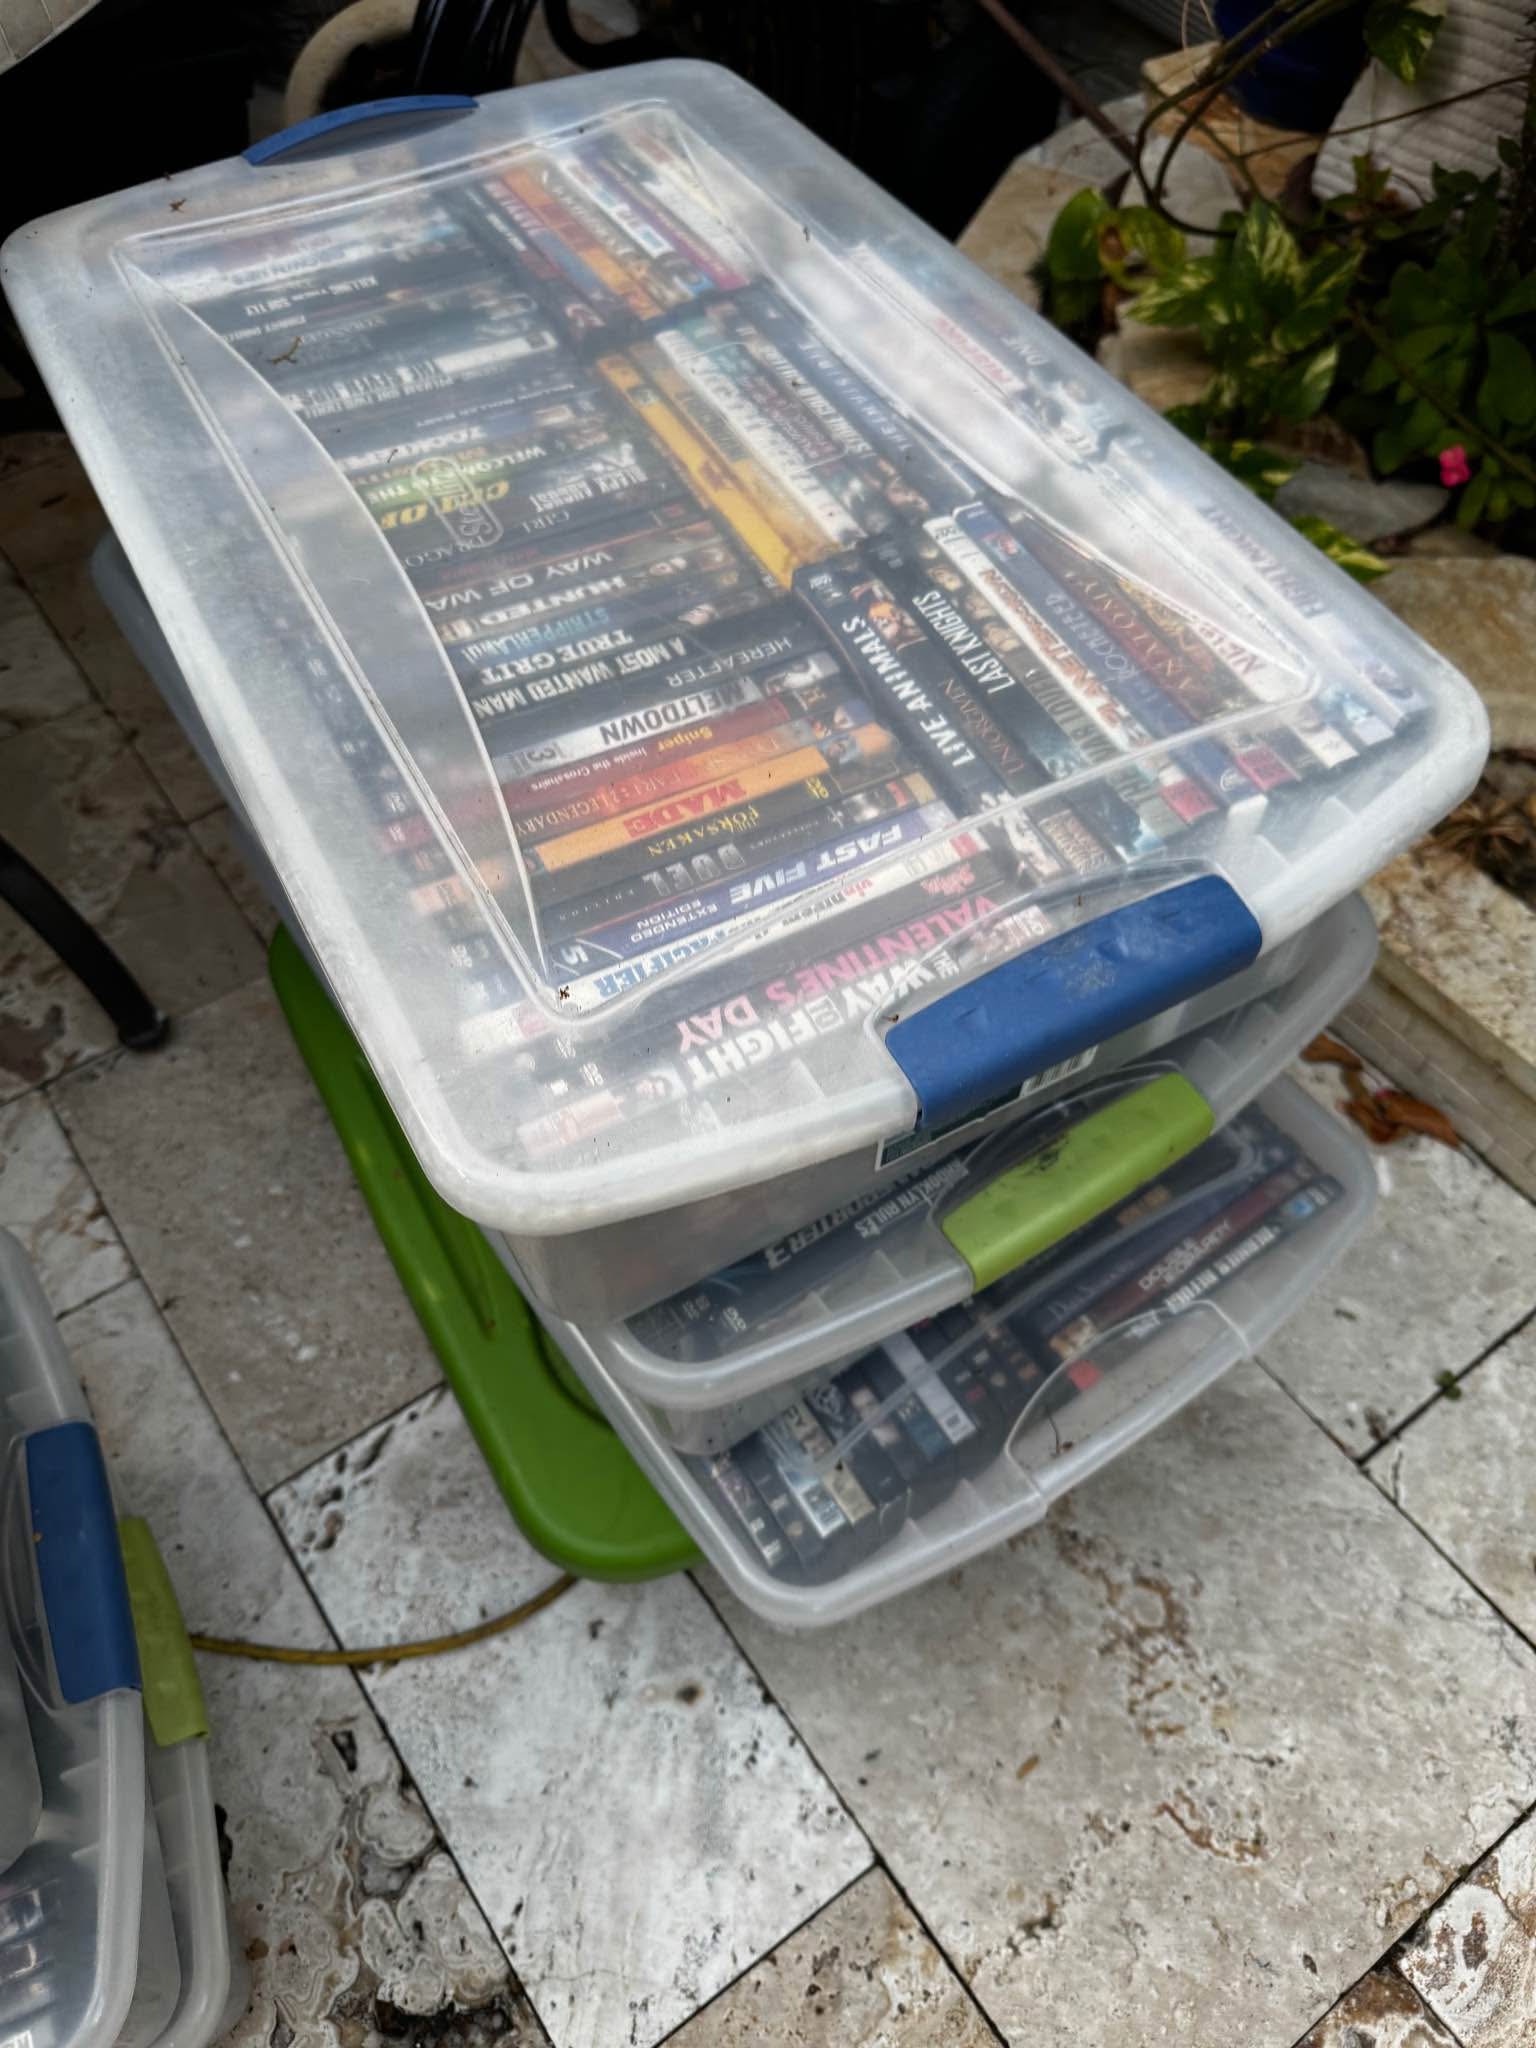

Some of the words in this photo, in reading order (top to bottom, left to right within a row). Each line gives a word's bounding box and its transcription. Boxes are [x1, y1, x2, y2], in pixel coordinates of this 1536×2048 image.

[490, 571, 534, 595] OF
[546, 549, 613, 580] WAY
[422, 587, 482, 612] WA
[910, 586, 983, 657] KNIGHTS
[555, 626, 633, 664] TRUE
[615, 641, 670, 675] MOST
[664, 636, 791, 687] HEREAFTER
[668, 636, 685, 656] A
[839, 612, 933, 715] ANIMALS
[479, 648, 555, 687] GRIT
[526, 659, 612, 701] WANTED
[960, 648, 1016, 695] LAST
[471, 685, 526, 718] MAN
[598, 679, 746, 746] MELTDOWN
[612, 745, 647, 765] Inside
[655, 723, 712, 754] Sniper
[918, 713, 976, 767] LIVE
[529, 764, 591, 791] Crosshairs
[591, 757, 611, 772] the
[513, 791, 610, 837] LEGENDARY
[621, 776, 748, 840] MADE
[645, 803, 760, 857] FORSAKEN
[816, 822, 903, 872] FAST
[641, 841, 745, 899] DUEL
[727, 859, 809, 904] FIVE
[629, 901, 718, 944] EXTENDED
[635, 898, 702, 930] EDITION
[762, 896, 998, 1013] VALENTINE'S
[839, 955, 937, 1020] WAY
[676, 992, 760, 1054] DAY
[684, 1008, 818, 1090] FIGHT
[852, 1199, 902, 1240] RULES
[762, 1246, 792, 1271] 3
